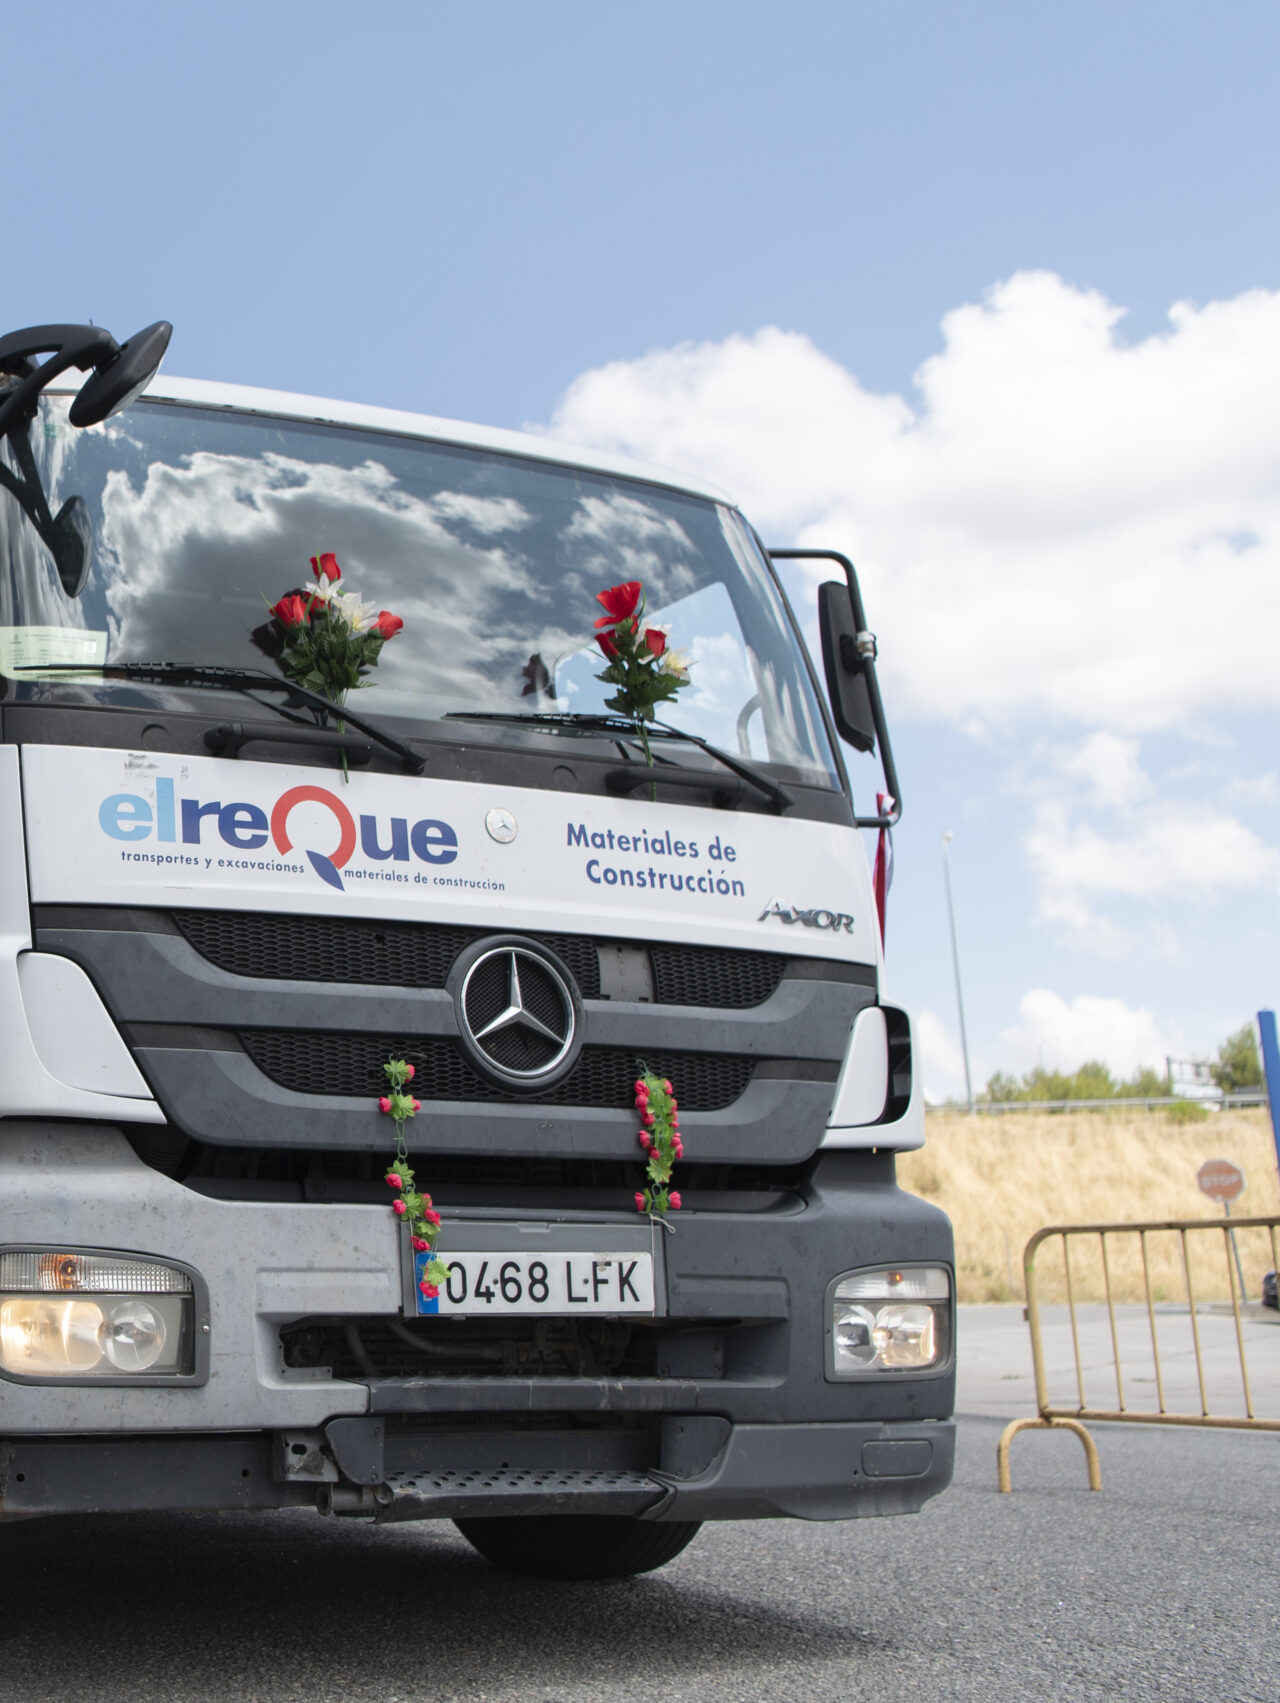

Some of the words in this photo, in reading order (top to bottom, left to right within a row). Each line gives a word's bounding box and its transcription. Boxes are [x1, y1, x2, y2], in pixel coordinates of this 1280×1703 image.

[98, 777, 458, 892] elreQue
[567, 823, 699, 859] Materiales
[708, 836, 737, 862] de
[121, 850, 199, 868] transportes
[204, 858, 212, 869] y
[217, 859, 305, 873] excavaciones
[344, 868, 409, 884] materiales
[413, 872, 429, 886] de
[586, 860, 746, 897] Construcción
[757, 896, 855, 934] AXOR
[1202, 1174, 1238, 1189] STOP
[446, 1261, 550, 1304] 0468
[566, 1260, 641, 1304] LFK
